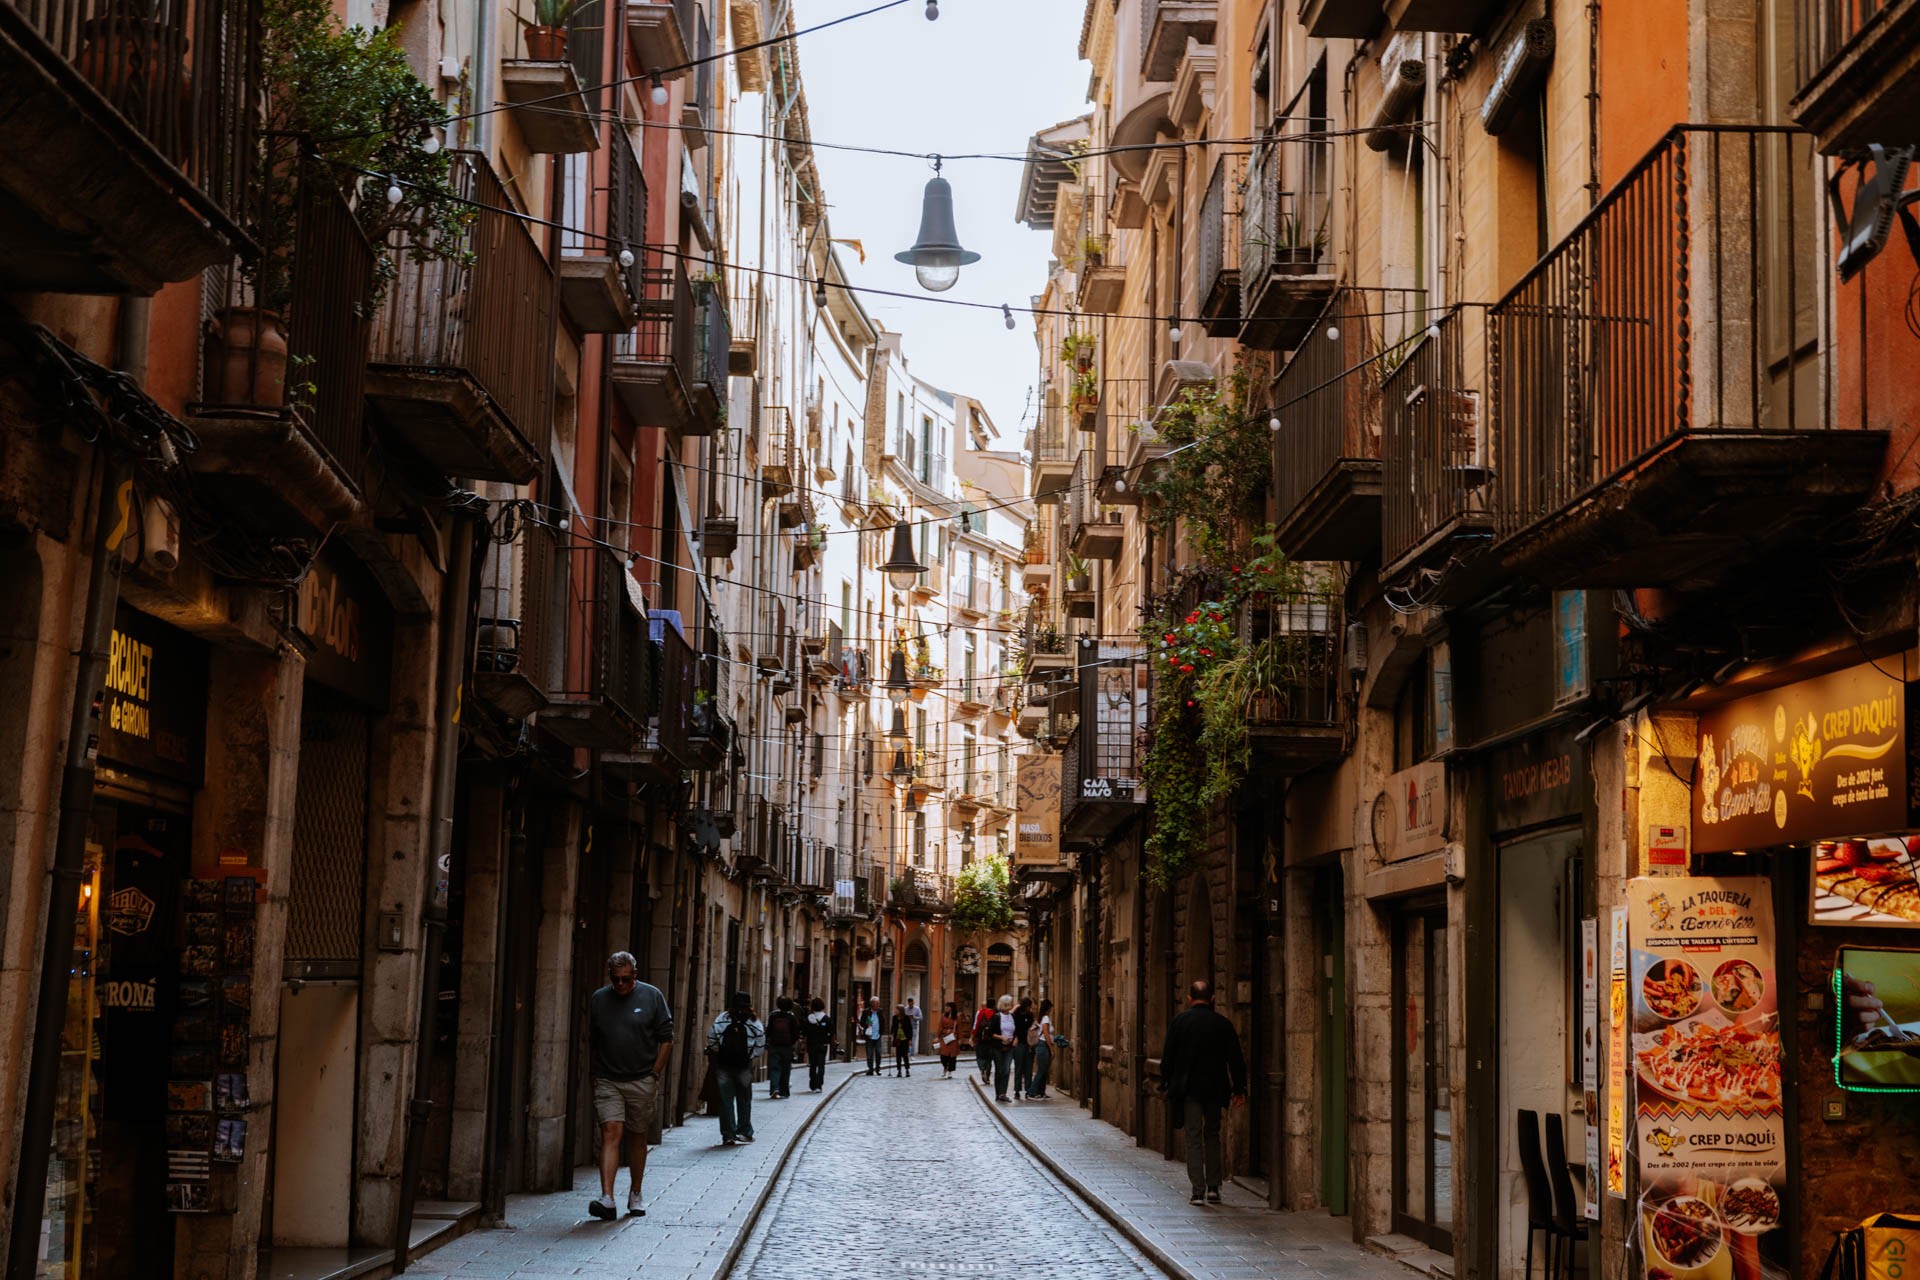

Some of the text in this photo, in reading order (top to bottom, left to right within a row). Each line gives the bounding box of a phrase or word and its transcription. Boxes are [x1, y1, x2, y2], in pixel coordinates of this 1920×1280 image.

[105, 628, 154, 703] RCADET
[110, 696, 121, 730] de
[121, 699, 150, 741] GIRONA
[1822, 708, 1850, 742] CREP
[1853, 685, 1897, 737] D'AQUÍ!
[1083, 778, 1109, 788] CASA
[1503, 753, 1571, 801] TANDORI KEBAB
[1836, 767, 1884, 788] Des de 2002 fent
[1083, 787, 1112, 797] MASÓ
[1832, 783, 1889, 808] creps de tota la vida
[1019, 833, 1053, 843] DIBUIXOS
[1681, 890, 1752, 912] LA TAQUERÍA
[1709, 906, 1727, 916] DEL
[1680, 917, 1725, 932] Barri
[1689, 1129, 1776, 1147] CREP D'AQUÍ!
[1661, 1161, 1671, 1169] de
[1672, 1161, 1690, 1169] 2002
[1691, 1161, 1707, 1170] fent
